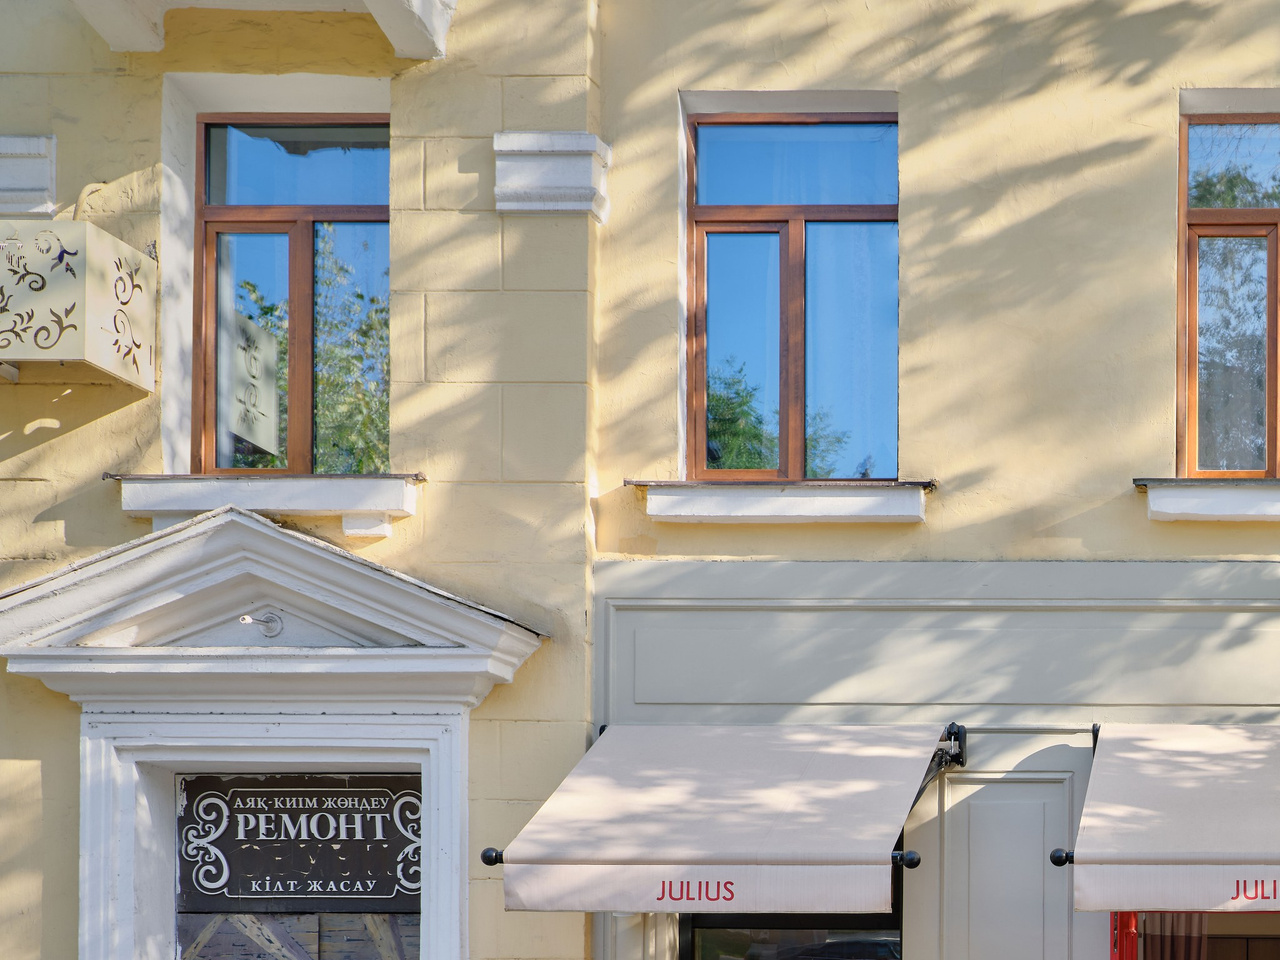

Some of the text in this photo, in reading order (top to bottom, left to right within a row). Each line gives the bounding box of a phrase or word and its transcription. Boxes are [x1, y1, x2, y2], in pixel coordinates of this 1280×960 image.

[322, 797, 390, 811] ЖӨНДЕУ
[234, 812, 391, 841] РЕМОНТ
[306, 879, 377, 892] ЖАСАУ
[656, 880, 735, 902] JULIUS
